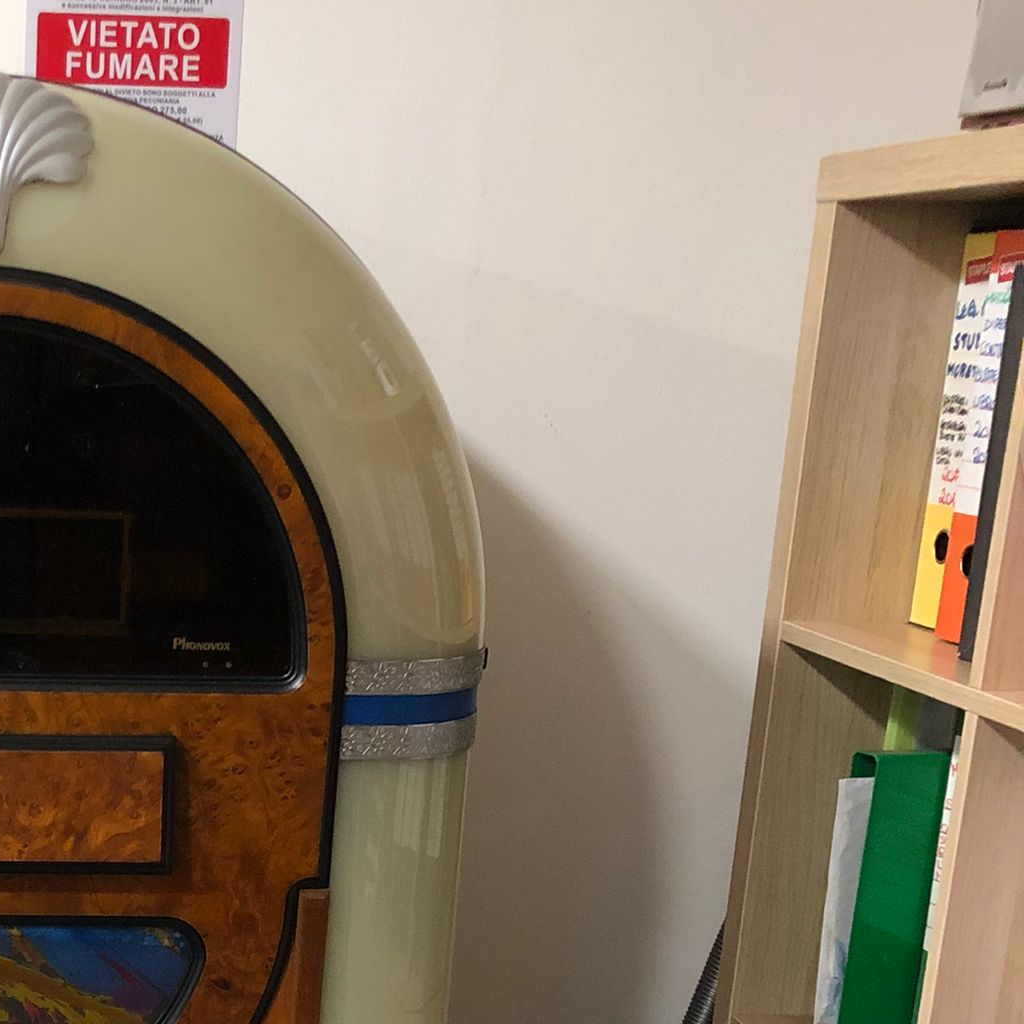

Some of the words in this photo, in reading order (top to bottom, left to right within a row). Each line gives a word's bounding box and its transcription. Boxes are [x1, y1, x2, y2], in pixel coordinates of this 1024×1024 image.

[67, 18, 201, 50] VIETATO
[65, 51, 201, 82] FUMARE
[142, 89, 162, 97] SONO
